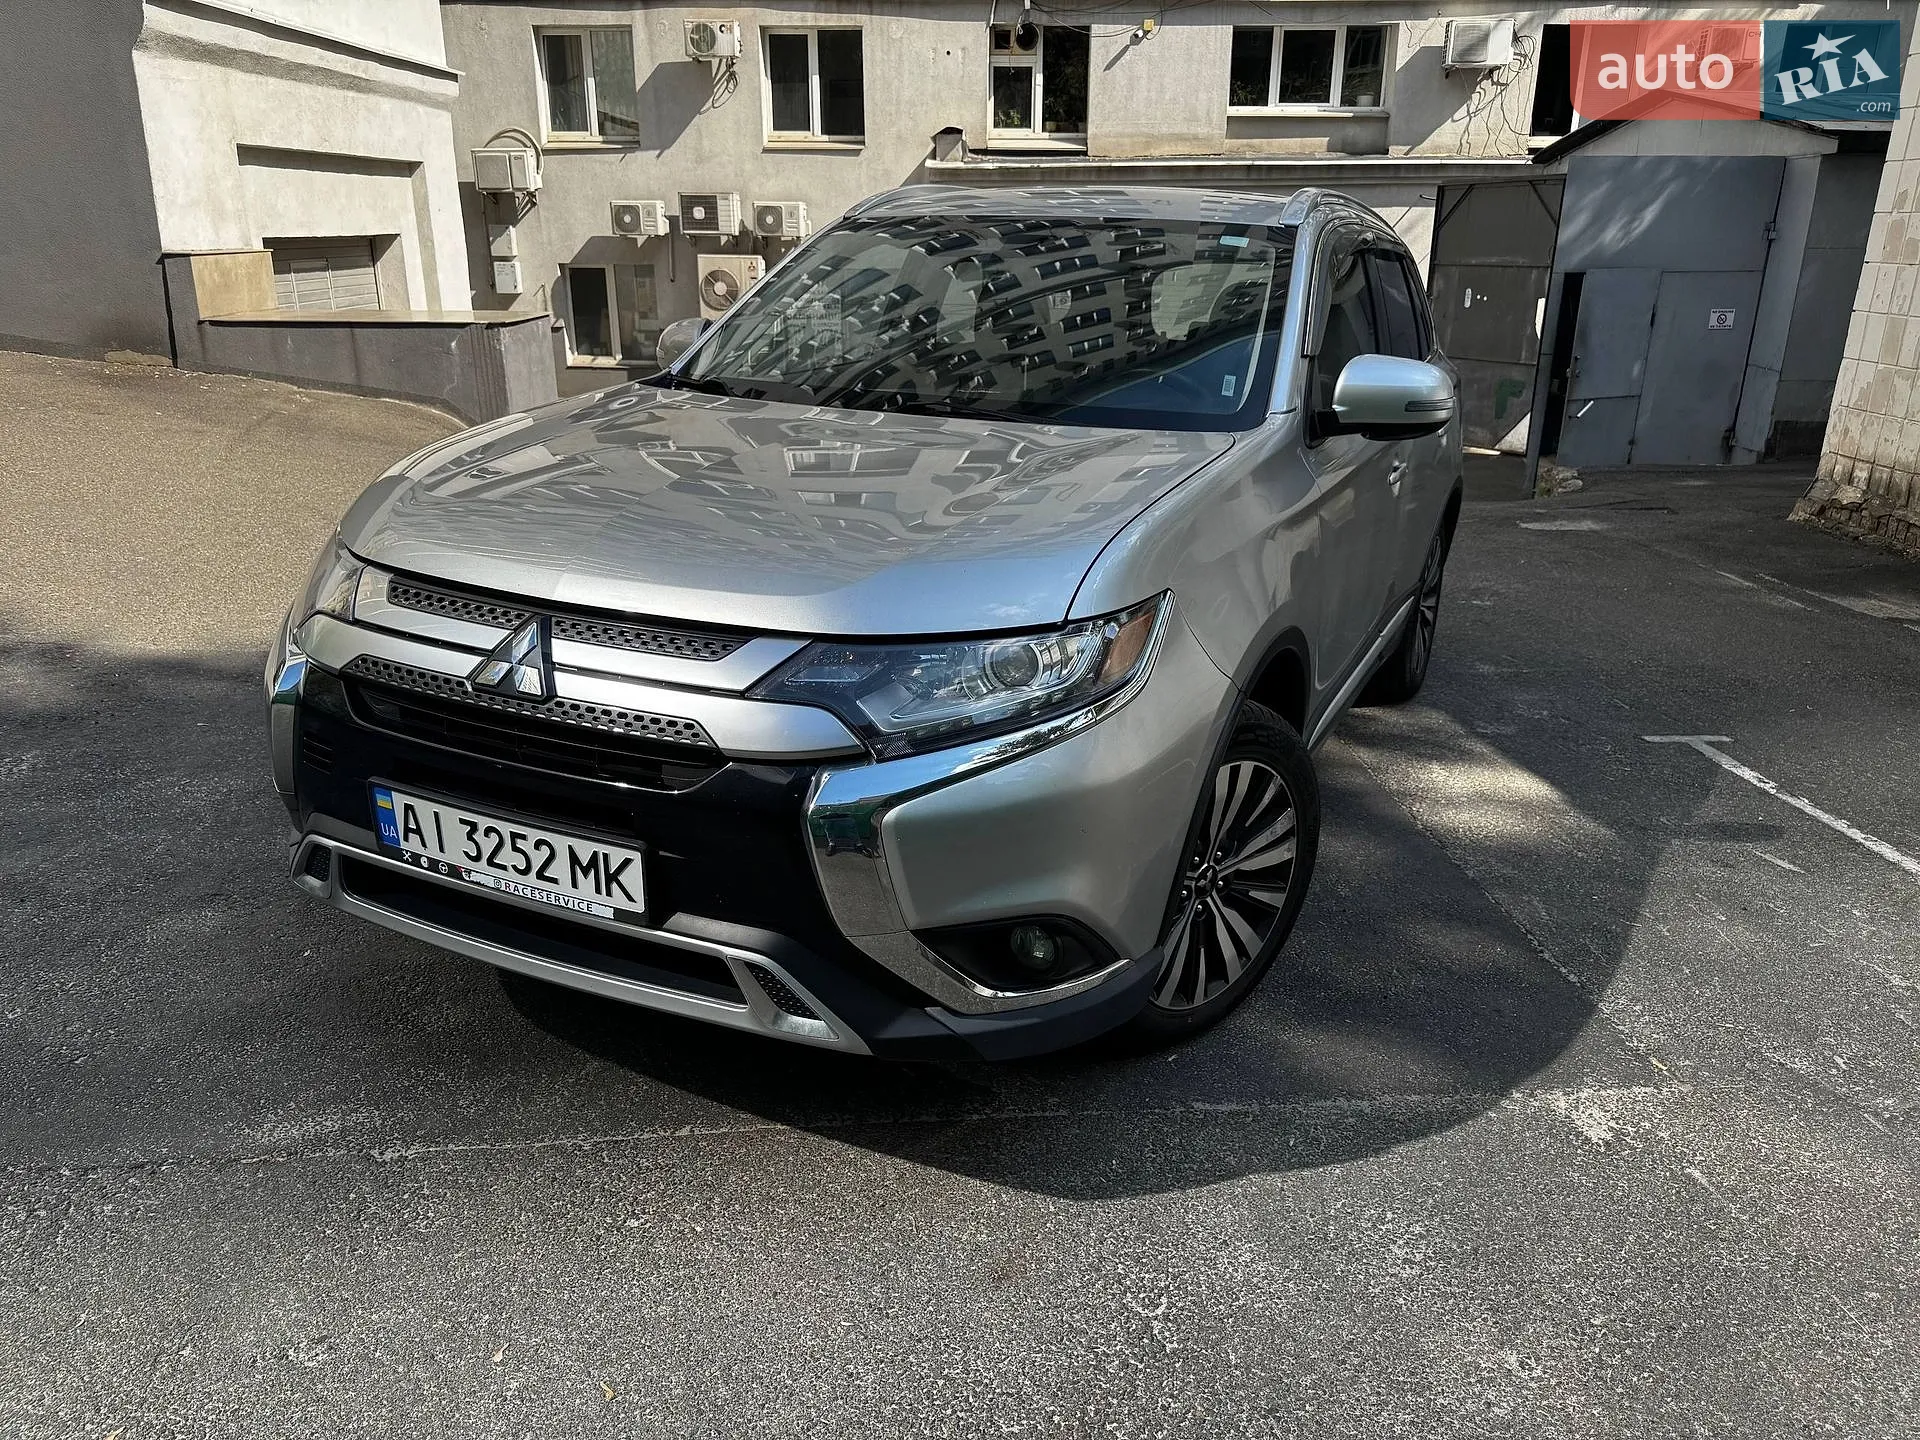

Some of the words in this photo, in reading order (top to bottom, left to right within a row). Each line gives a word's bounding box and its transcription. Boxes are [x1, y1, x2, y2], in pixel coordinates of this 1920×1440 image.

[381, 822, 398, 839] UA
[402, 801, 446, 854] AI
[458, 816, 560, 885] 3252
[567, 843, 637, 904] MK
